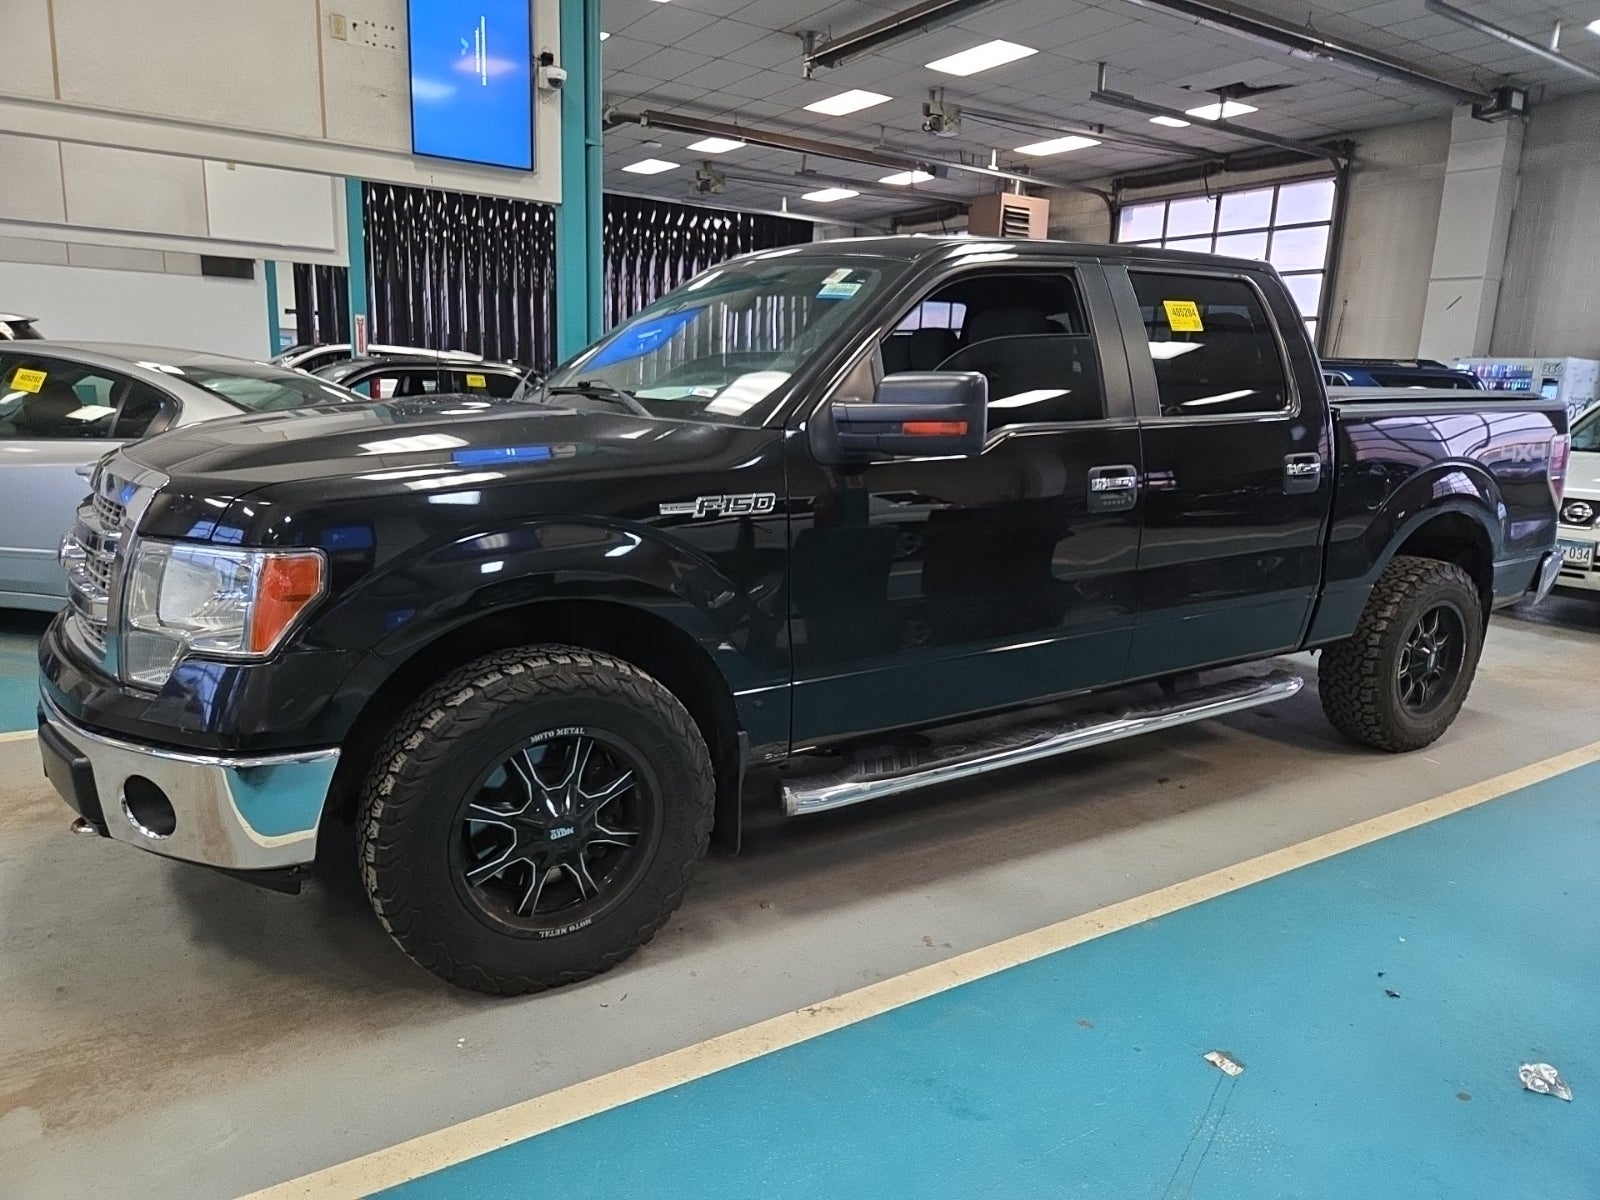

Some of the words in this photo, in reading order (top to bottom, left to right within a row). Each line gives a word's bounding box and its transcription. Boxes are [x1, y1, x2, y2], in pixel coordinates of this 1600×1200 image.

[1172, 307, 1197, 318] 405284
[1568, 547, 1590, 560] 034
[530, 730, 555, 744] MOTO
[556, 727, 585, 736] METAL
[569, 918, 592, 932] MOTO
[539, 926, 568, 938] METAL
